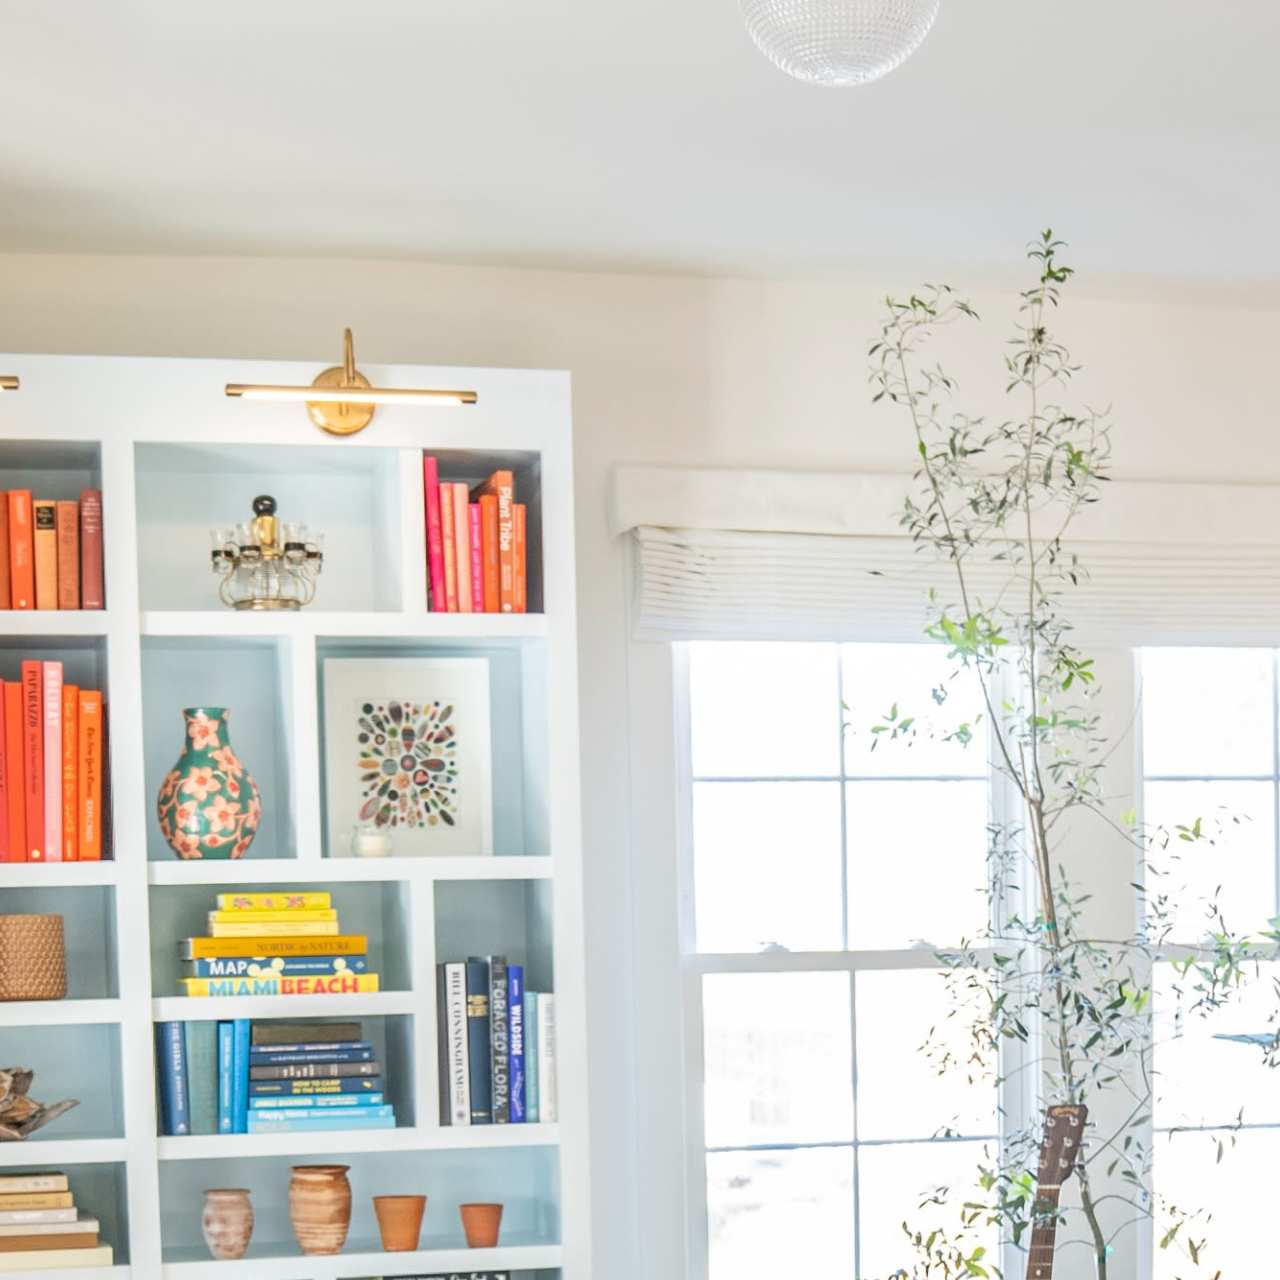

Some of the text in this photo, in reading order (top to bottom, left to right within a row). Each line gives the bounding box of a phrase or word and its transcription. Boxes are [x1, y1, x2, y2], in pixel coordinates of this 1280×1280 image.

[498, 487, 512, 518] Plant
[500, 521, 513, 551] Tribe
[210, 961, 247, 976] MAP
[451, 971, 461, 996] BILL
[208, 977, 359, 996] MIAMI BEACH
[493, 980, 507, 1052] FORAGED
[511, 1004, 523, 1056] WILDSIDE
[453, 1002, 464, 1086] CUNNINGHAM
